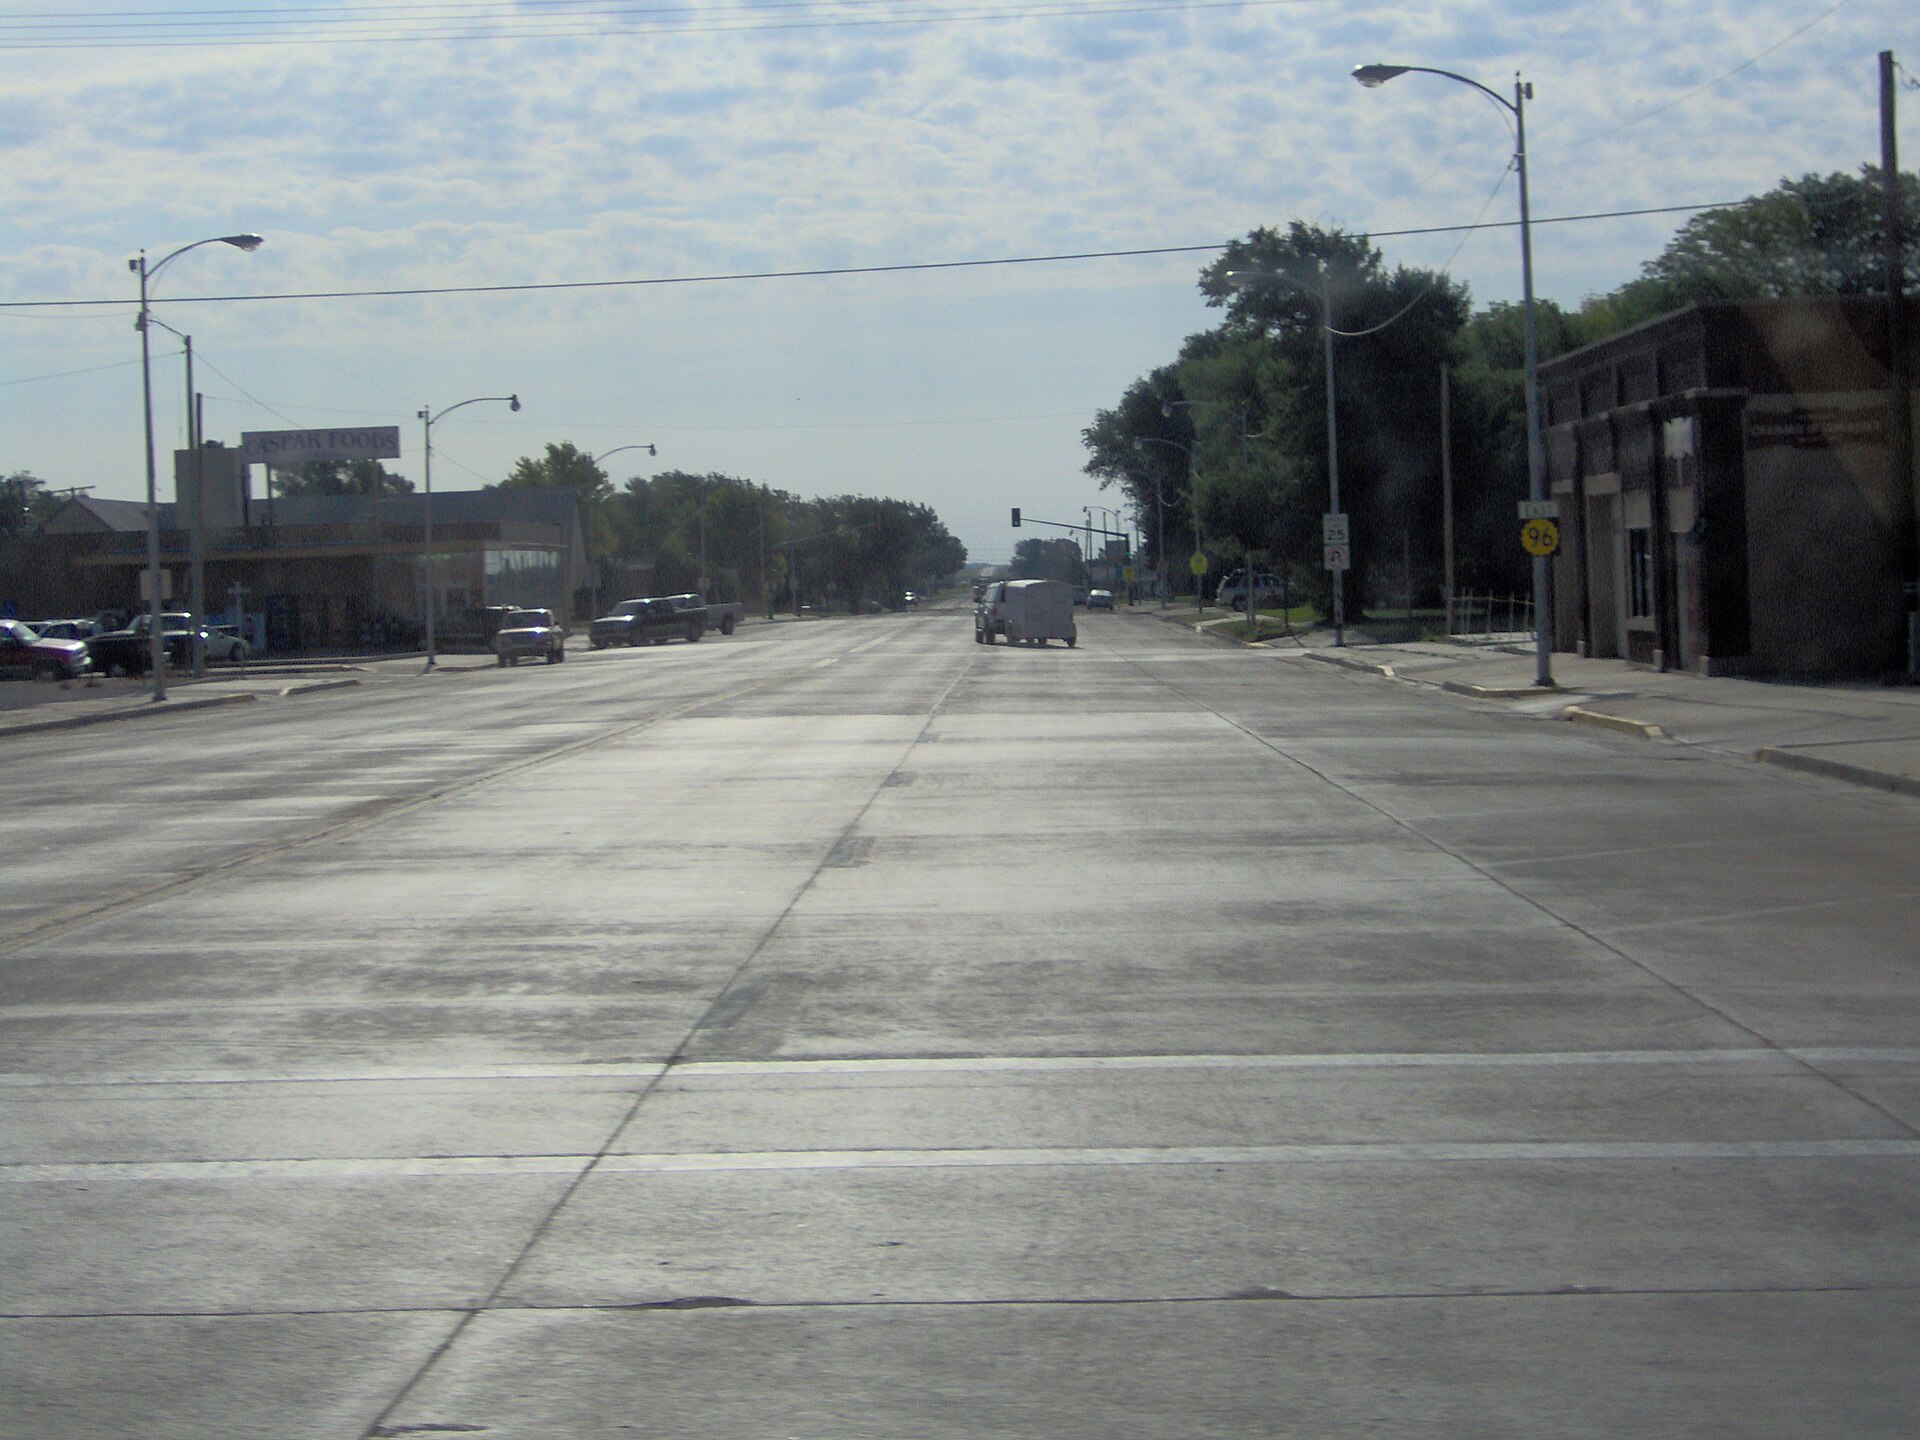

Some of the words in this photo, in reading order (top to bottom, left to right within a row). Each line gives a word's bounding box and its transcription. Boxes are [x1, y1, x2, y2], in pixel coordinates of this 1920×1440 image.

[328, 431, 396, 450] FOODS
[1327, 529, 1345, 541] 25
[1528, 527, 1553, 547] 96
